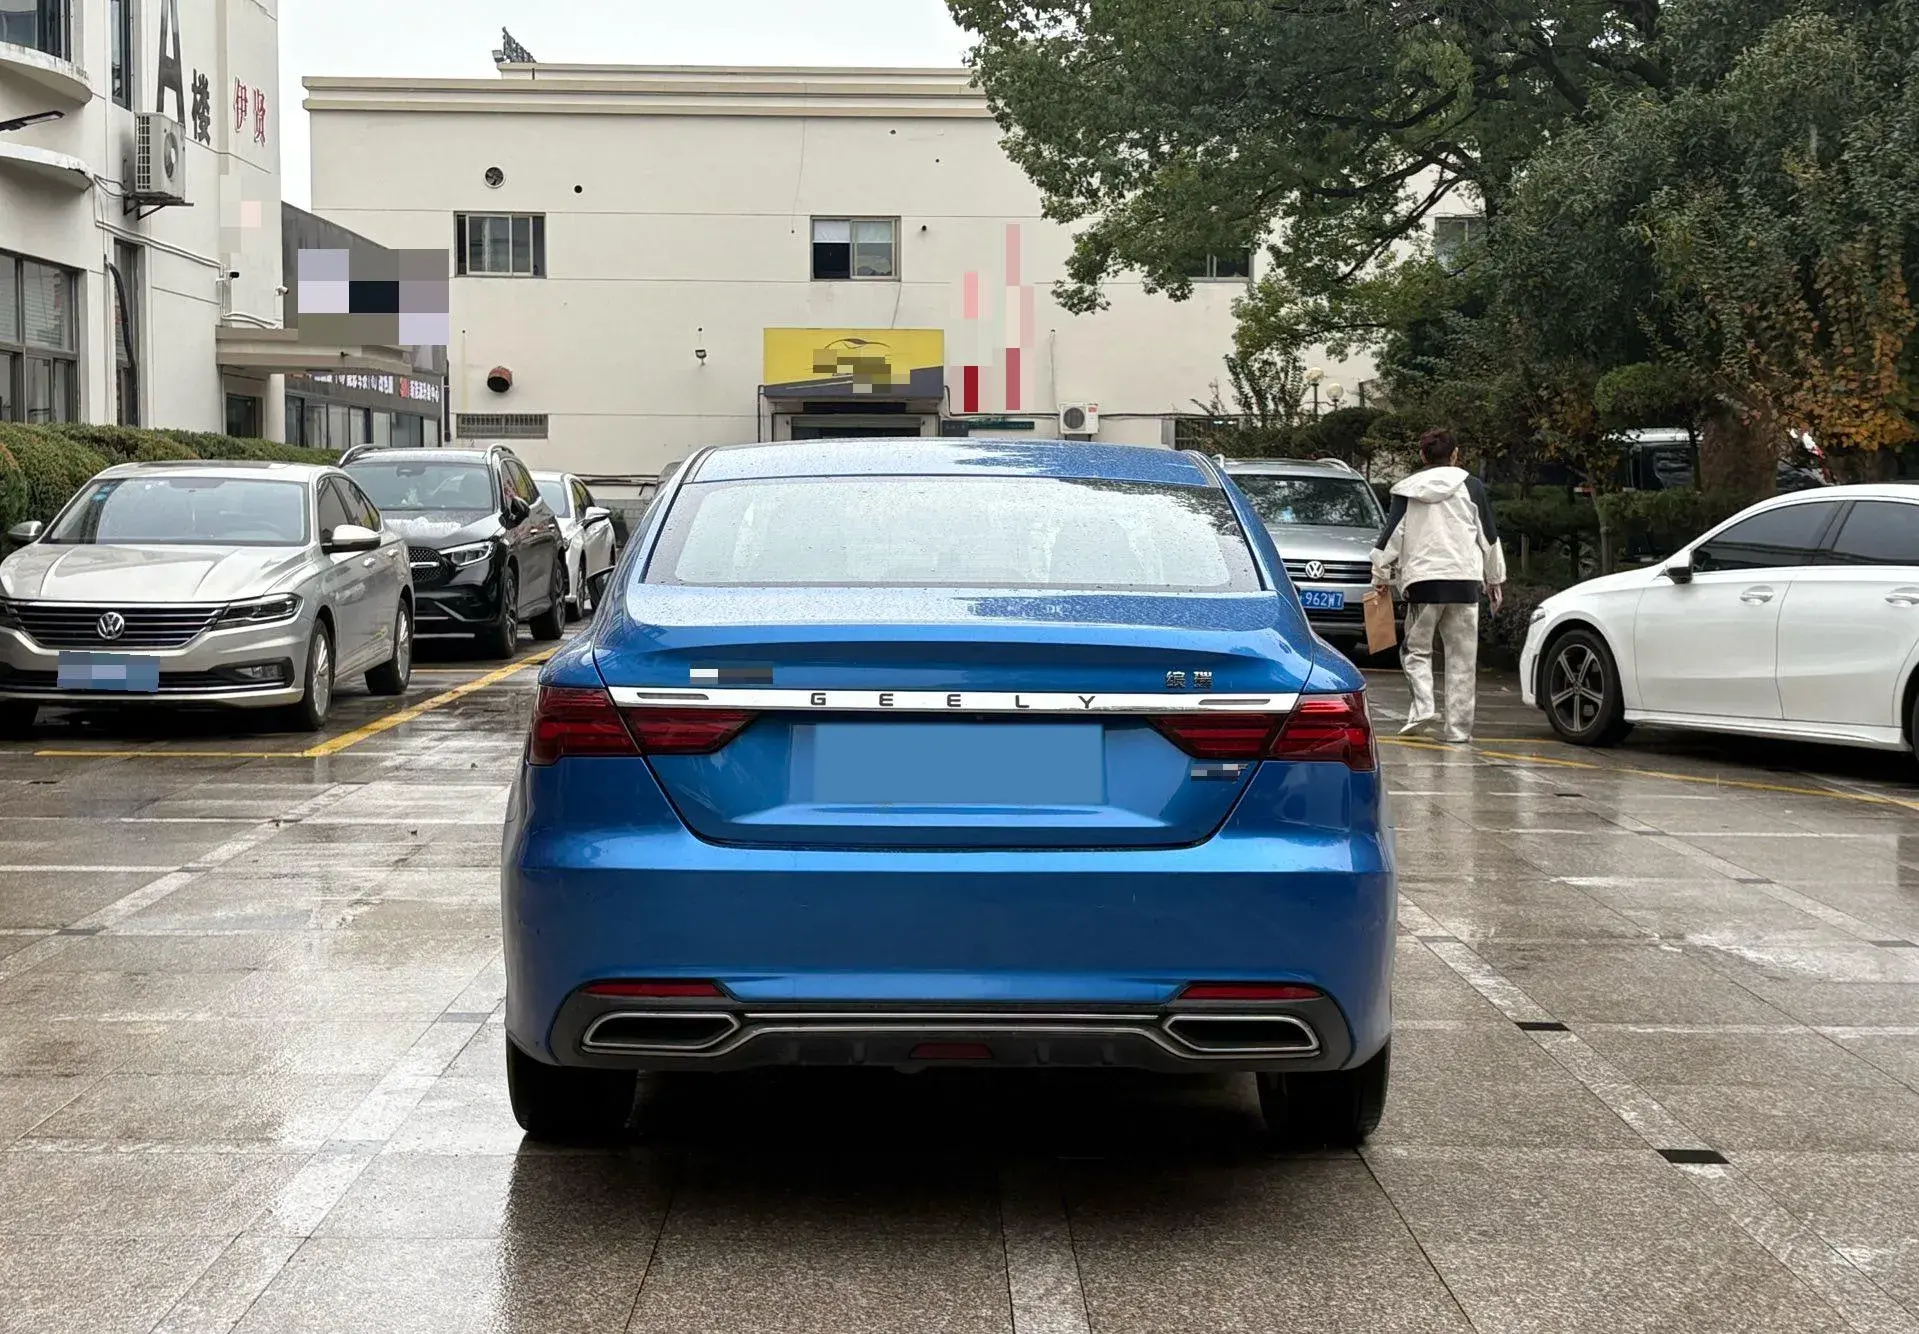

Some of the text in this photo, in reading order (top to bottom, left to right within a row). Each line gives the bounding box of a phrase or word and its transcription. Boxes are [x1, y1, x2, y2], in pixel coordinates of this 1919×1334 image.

[1305, 592, 1344, 609] 962W7
[1166, 670, 1212, 689] 缤瑞
[810, 692, 1096, 709] GEELY
